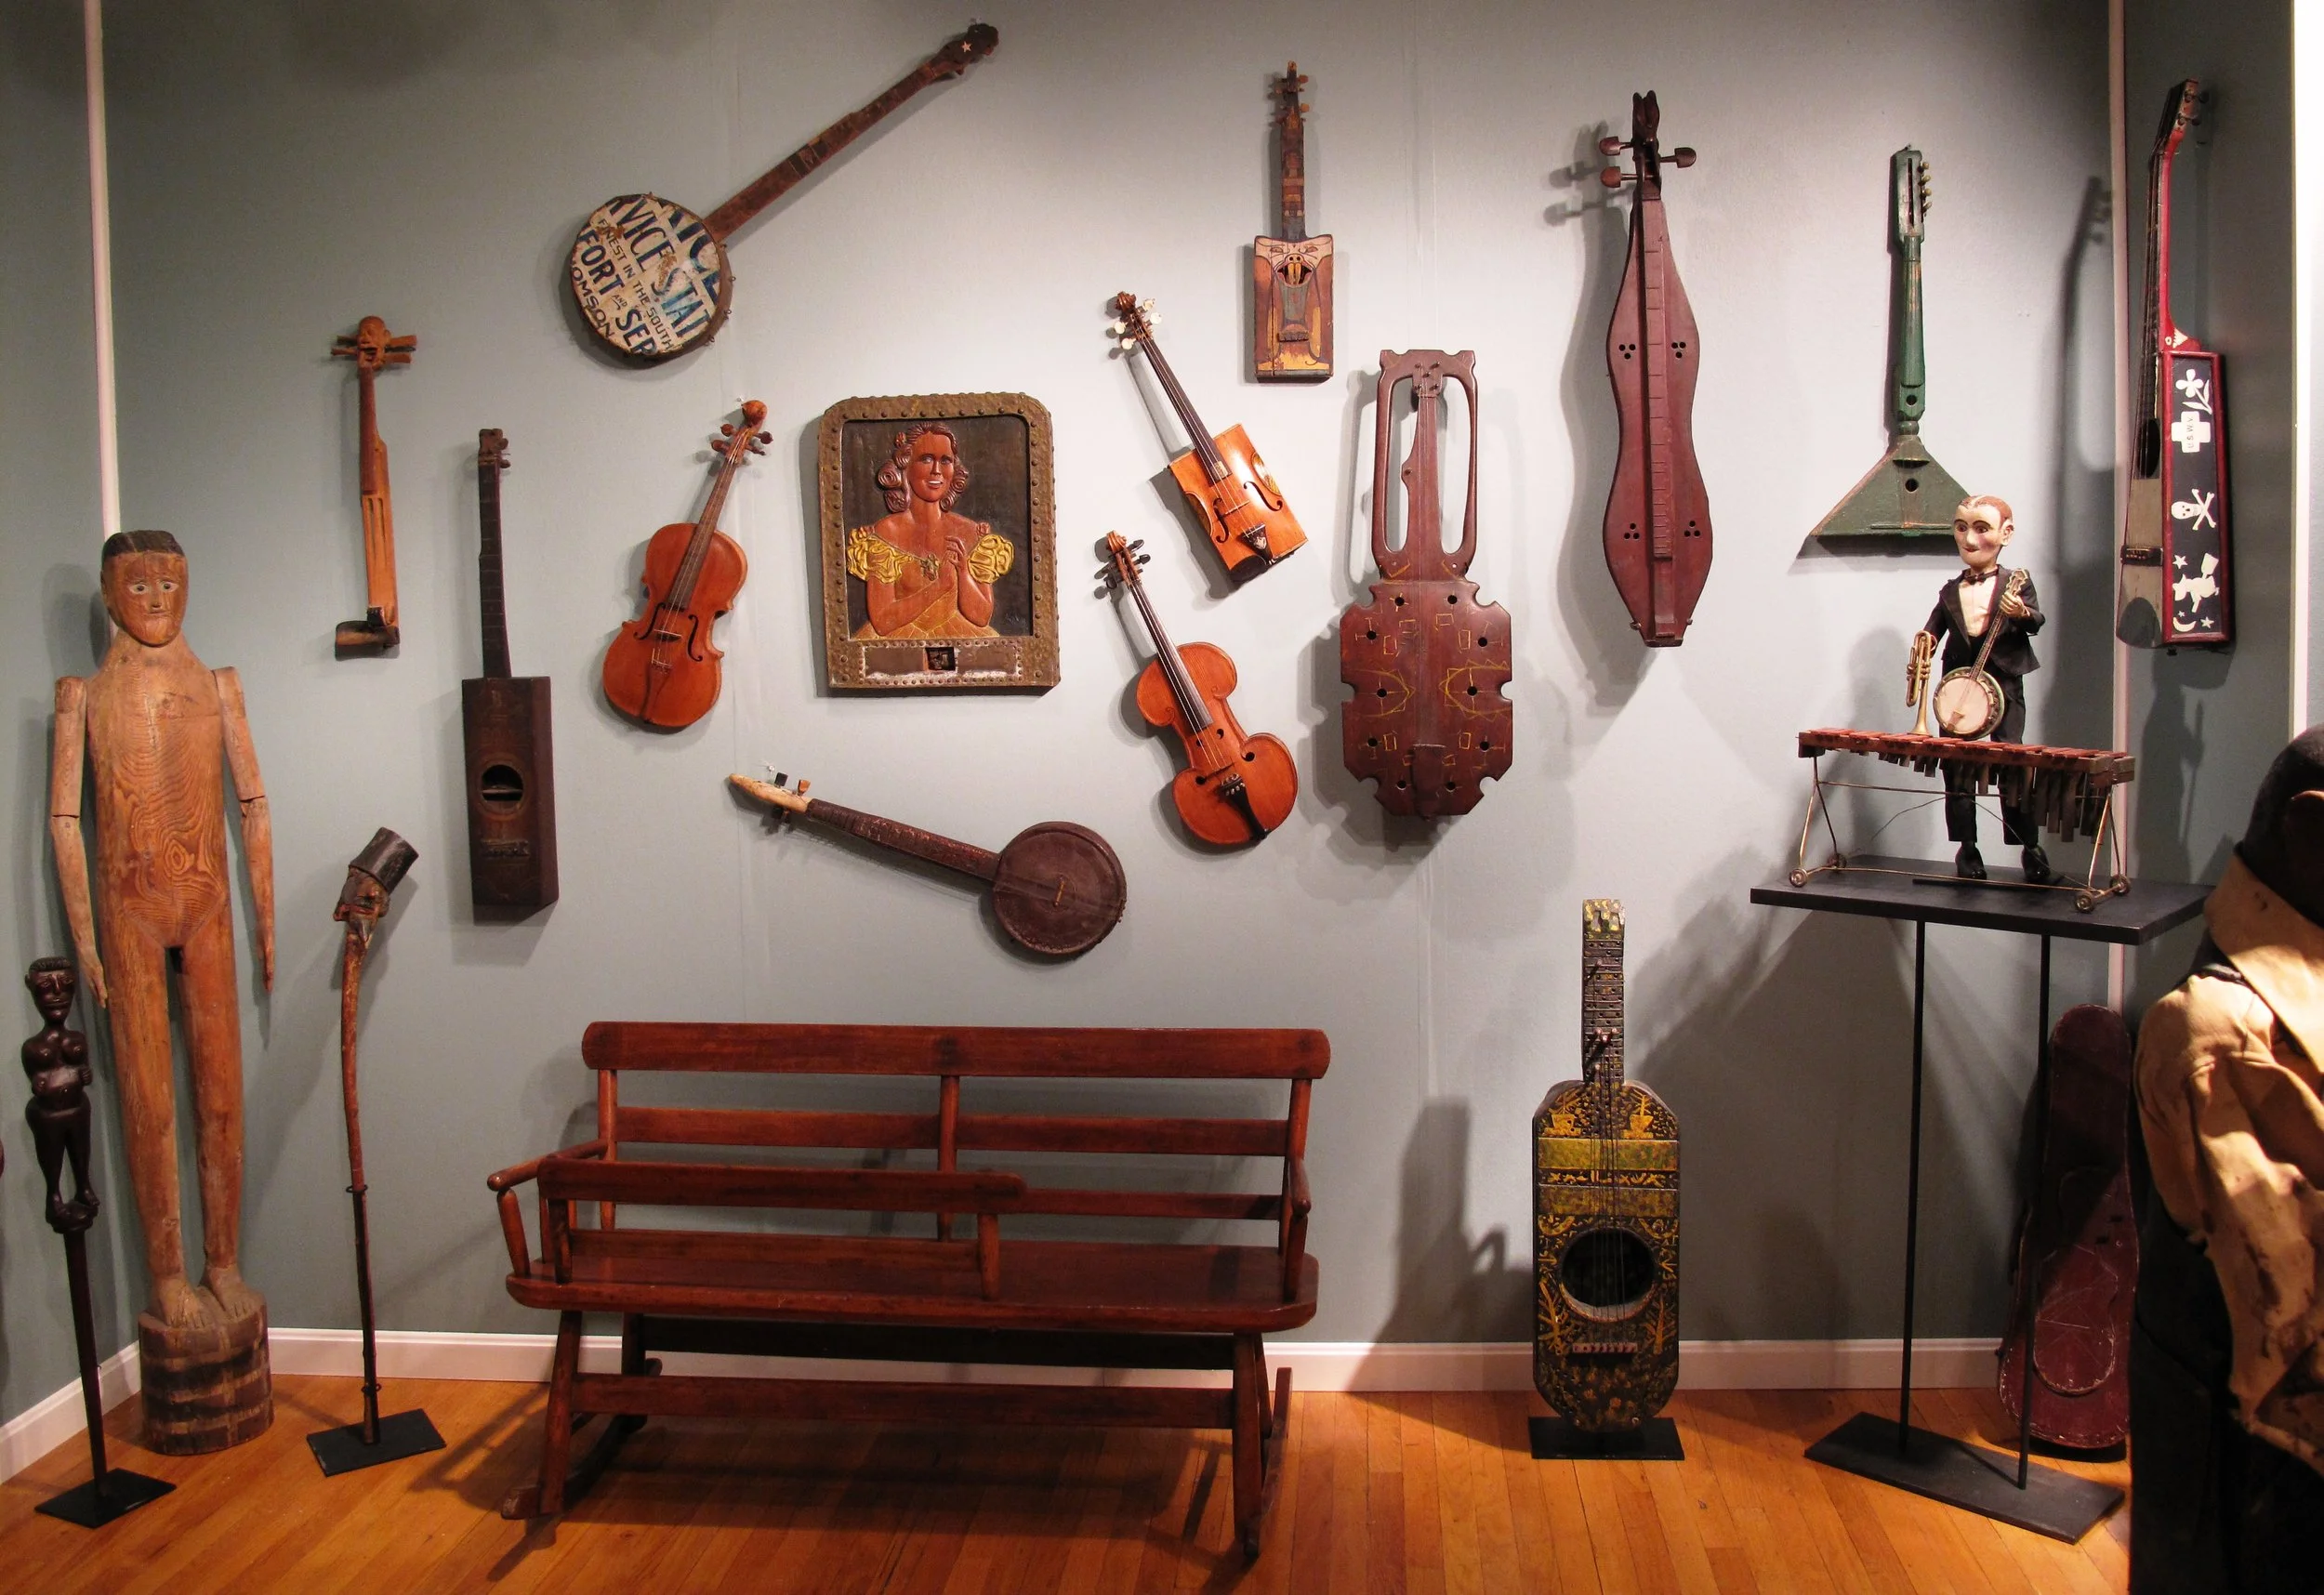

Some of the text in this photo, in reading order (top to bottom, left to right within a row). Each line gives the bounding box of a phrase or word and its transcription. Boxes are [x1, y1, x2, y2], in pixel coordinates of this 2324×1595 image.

[577, 224, 625, 296] FORT
[613, 294, 628, 308] AND
[598, 218, 675, 350] FINEST IN THE SOUTH
[651, 267, 712, 338] STAT
